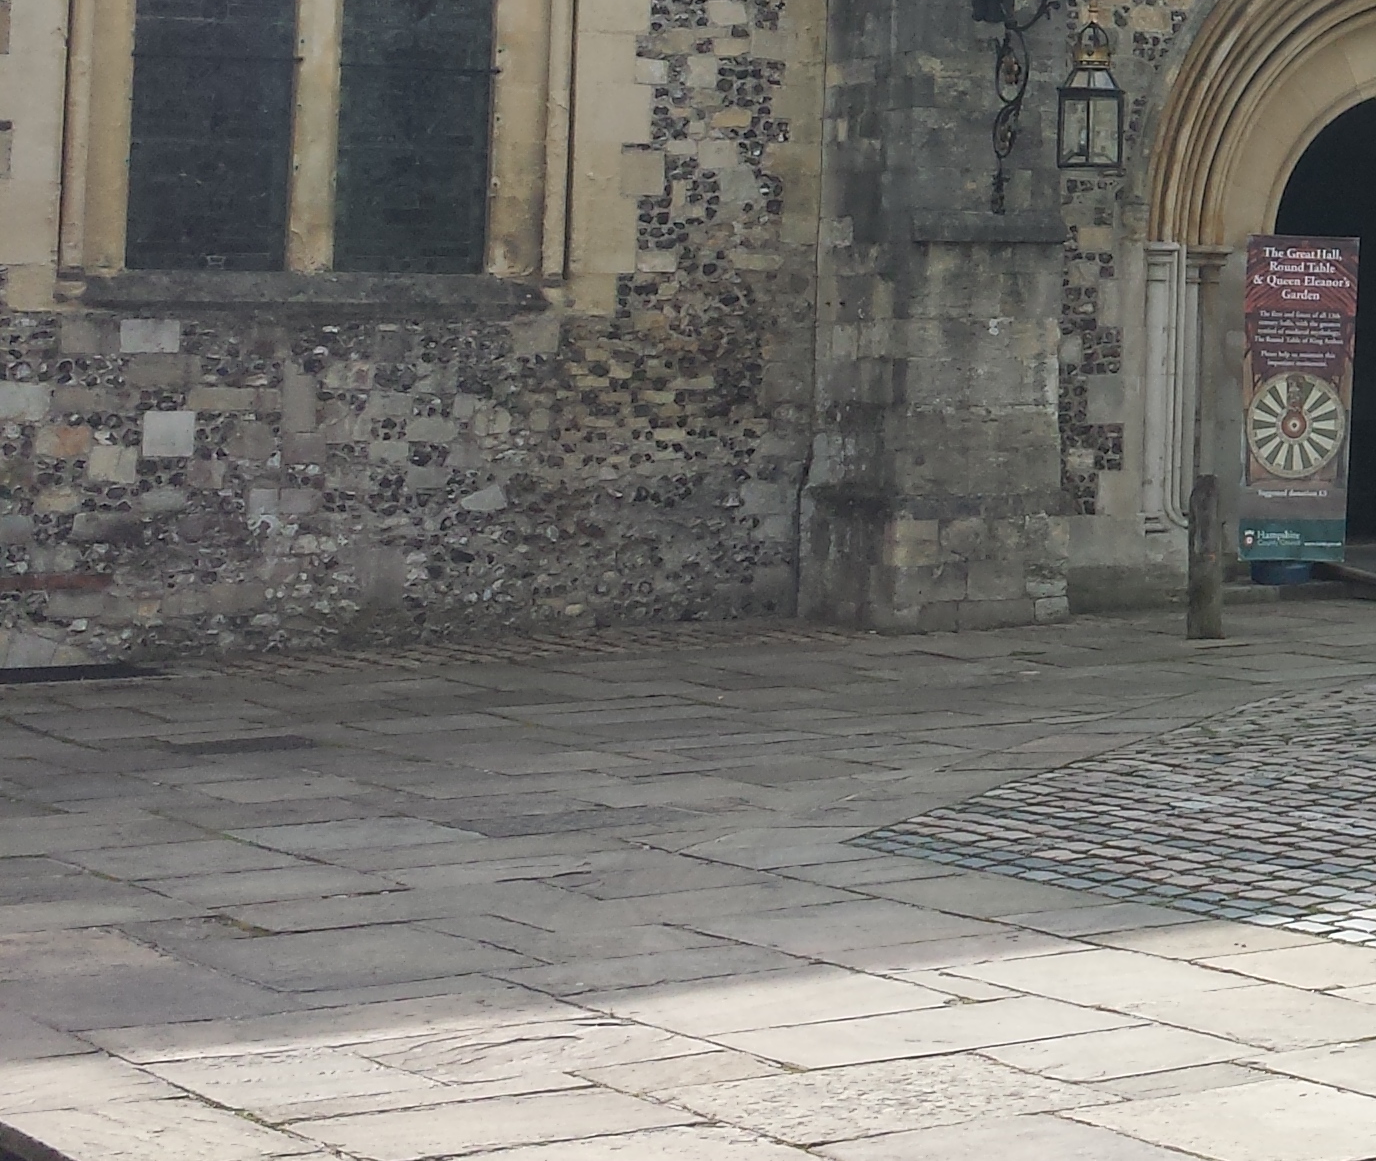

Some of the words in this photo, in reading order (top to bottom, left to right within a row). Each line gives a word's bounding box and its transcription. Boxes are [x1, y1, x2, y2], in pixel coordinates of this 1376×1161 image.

[1263, 247, 1284, 258] The
[1286, 248, 1315, 259] Great
[1317, 249, 1342, 261] Hall,
[1269, 261, 1304, 273] Round
[1307, 262, 1336, 273] Table
[1253, 274, 1264, 285] &
[1266, 275, 1300, 288] Queen
[1304, 275, 1350, 288] Eleanor's
[1281, 289, 1320, 301] Garden
[1286, 336, 1301, 344] Table
[1278, 351, 1290, 359] help
[1257, 530, 1301, 541] Hampshire
